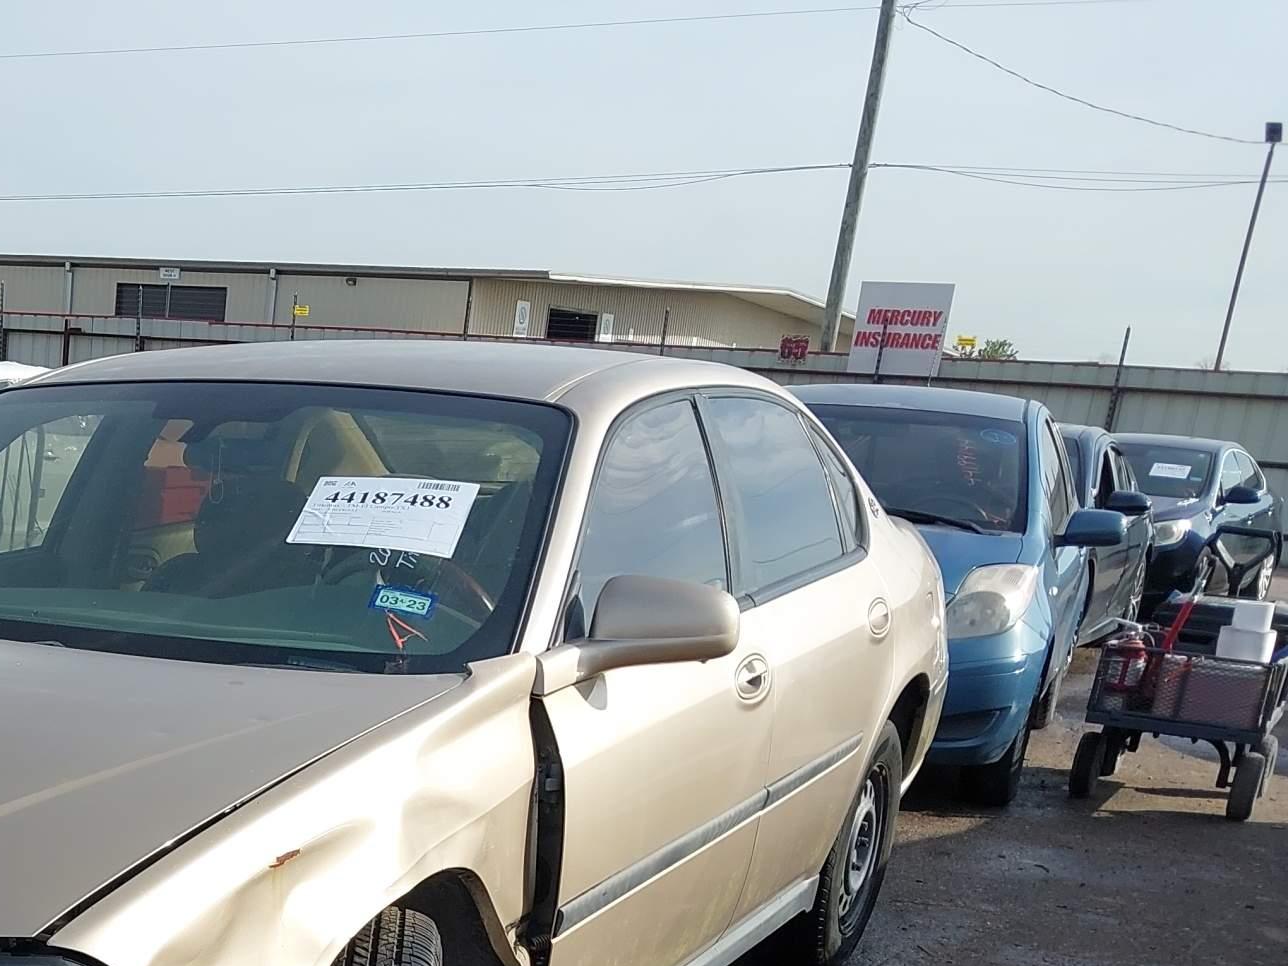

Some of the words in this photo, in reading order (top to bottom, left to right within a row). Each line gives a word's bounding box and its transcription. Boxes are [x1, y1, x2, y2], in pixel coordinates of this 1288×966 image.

[867, 308, 943, 327] MERCURY
[854, 331, 942, 350] INSURANCE
[324, 490, 453, 509] 44187488
[380, 594, 399, 605] 03
[406, 600, 426, 611] 23
